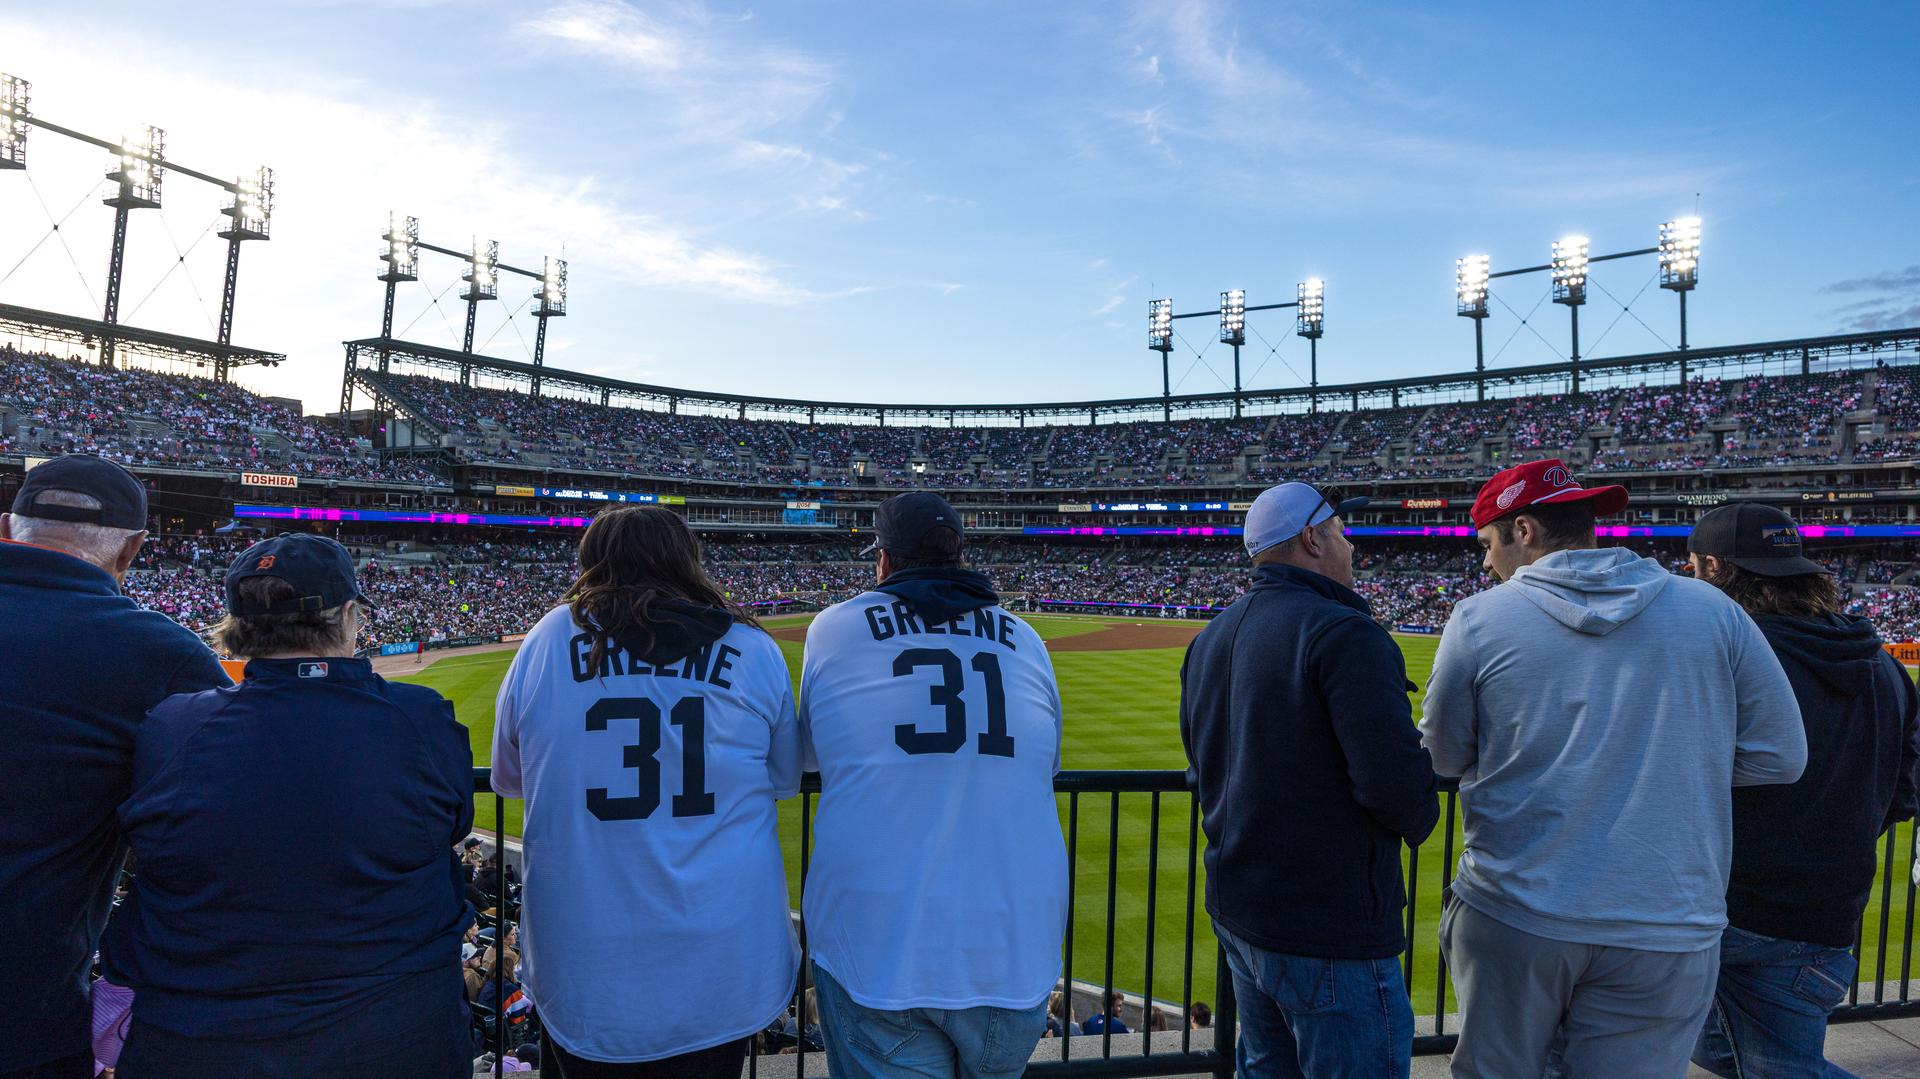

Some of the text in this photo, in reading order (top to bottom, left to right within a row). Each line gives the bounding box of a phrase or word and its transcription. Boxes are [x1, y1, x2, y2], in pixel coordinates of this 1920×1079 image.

[244, 474, 295, 486] TOSHIBA
[1677, 493, 1727, 502] CHAMPIONS
[570, 633, 741, 690] GRNE
[892, 648, 1014, 758] 31
[585, 697, 715, 821] 31
